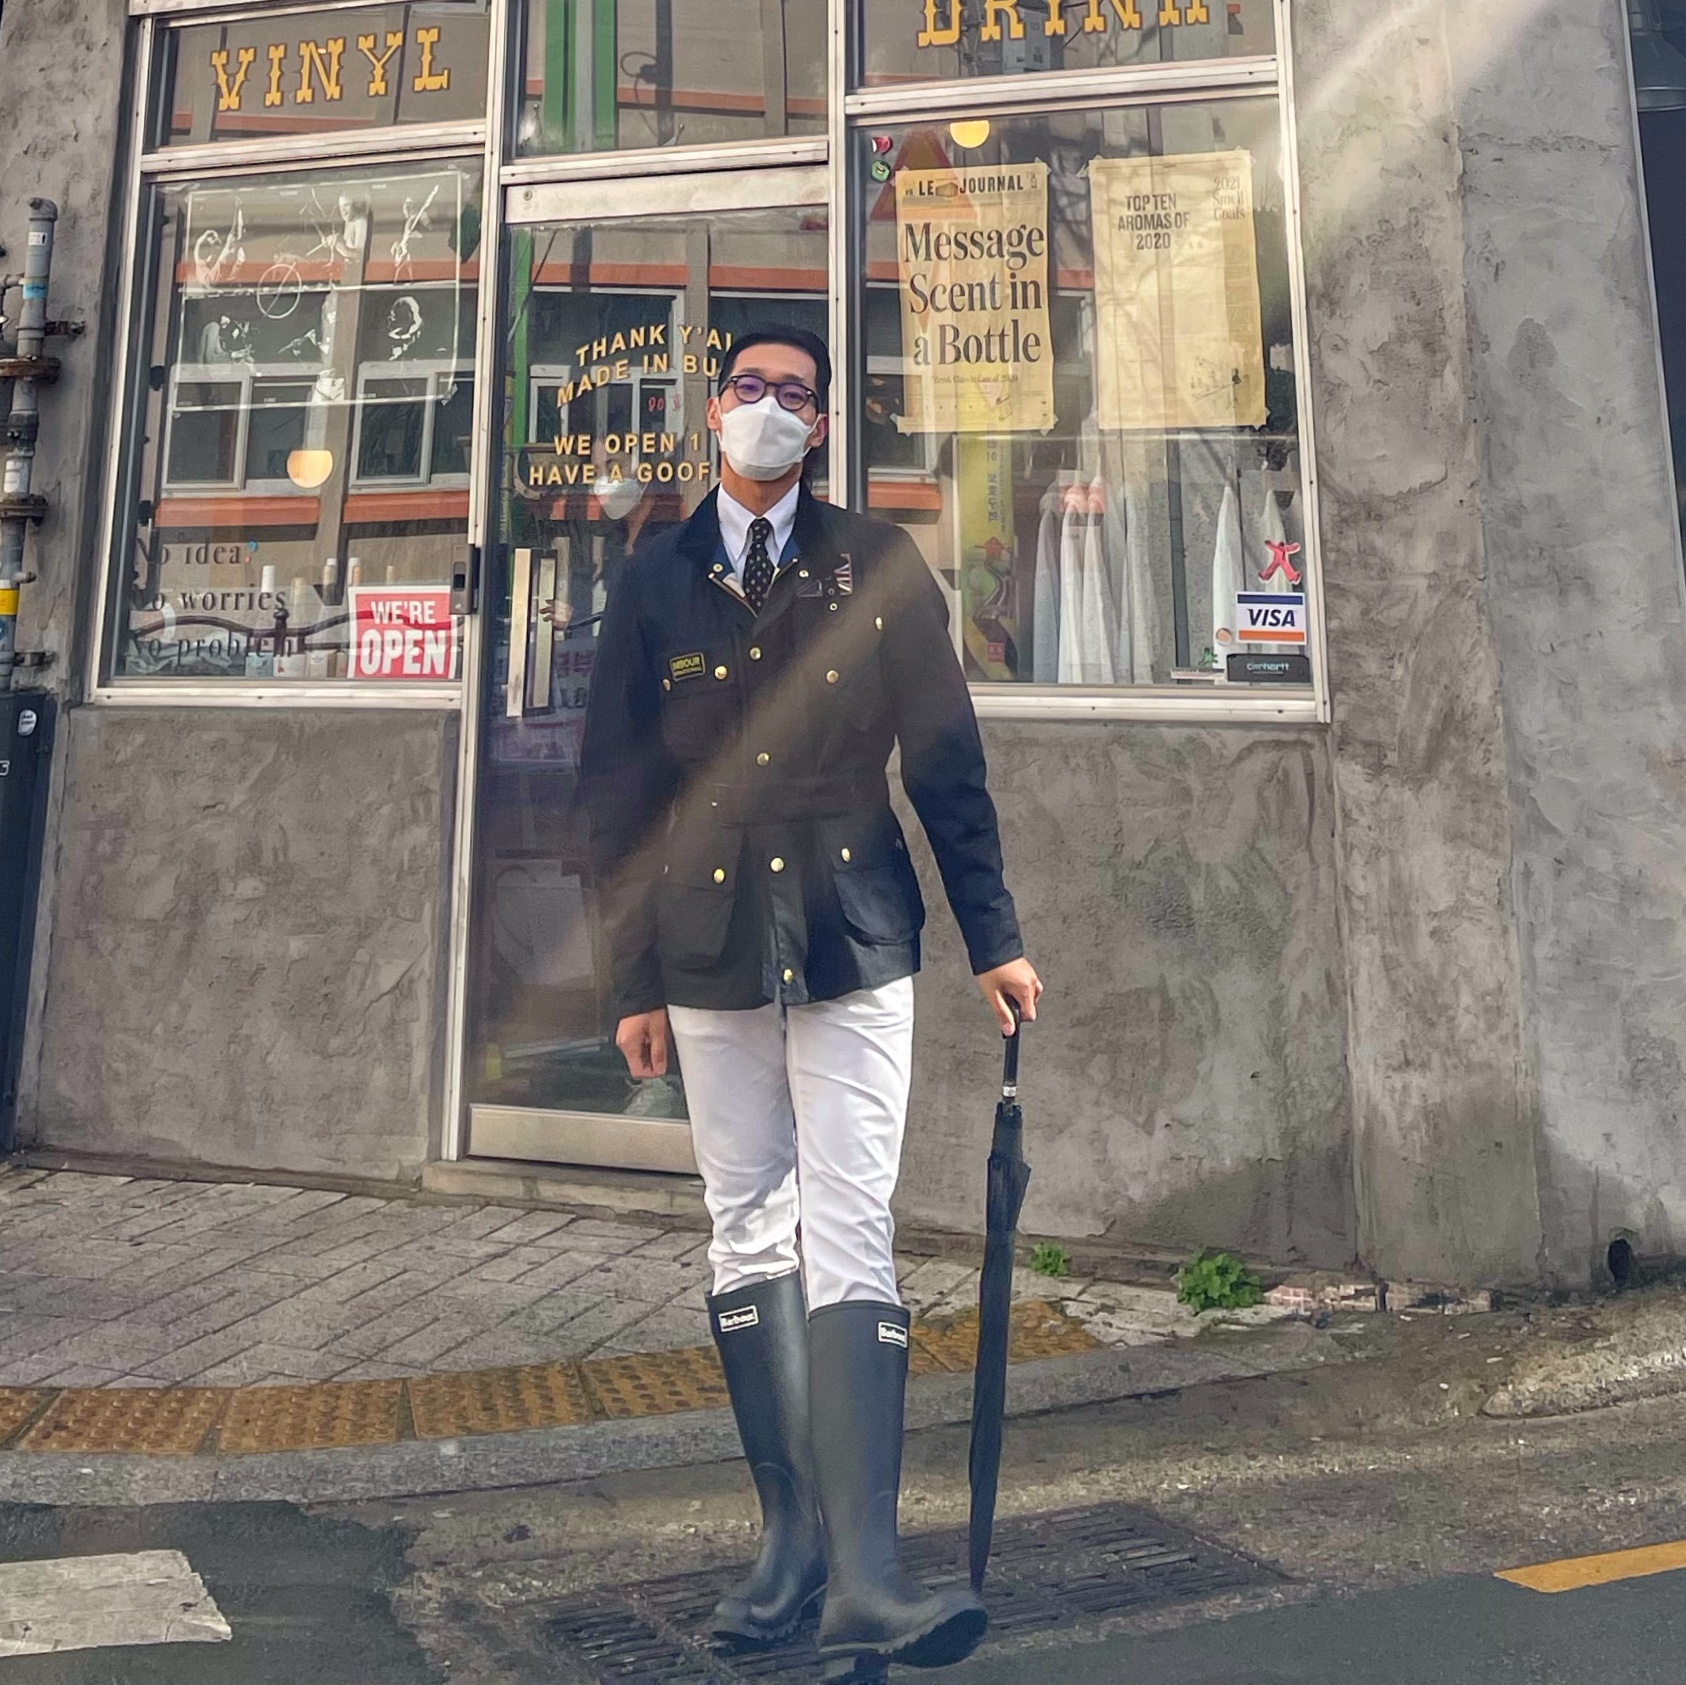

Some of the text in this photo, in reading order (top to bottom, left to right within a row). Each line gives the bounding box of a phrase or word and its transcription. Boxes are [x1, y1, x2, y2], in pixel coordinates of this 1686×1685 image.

[210, 26, 449, 111] VINYL
[919, 180, 934, 196] LE
[960, 174, 1023, 194] JOURNAL
[1124, 193, 1177, 212] TOP TEN
[1118, 212, 1190, 232] AROMAS OF
[904, 222, 1044, 271] Message
[1136, 232, 1171, 250] 2020
[910, 272, 1043, 314] Scent in
[576, 323, 667, 367] THANK
[913, 319, 1041, 366] a Bottle
[556, 358, 629, 408] MADE
[643, 352, 668, 374] IN
[554, 434, 592, 456] WE
[604, 432, 675, 455] OPEN
[529, 463, 596, 486] HAVE
[609, 464, 624, 483] A
[184, 541, 242, 565] idea
[179, 584, 287, 611] worries
[370, 600, 436, 625] WE'RE
[1247, 608, 1296, 627] VISA
[359, 628, 447, 675] OPEN
